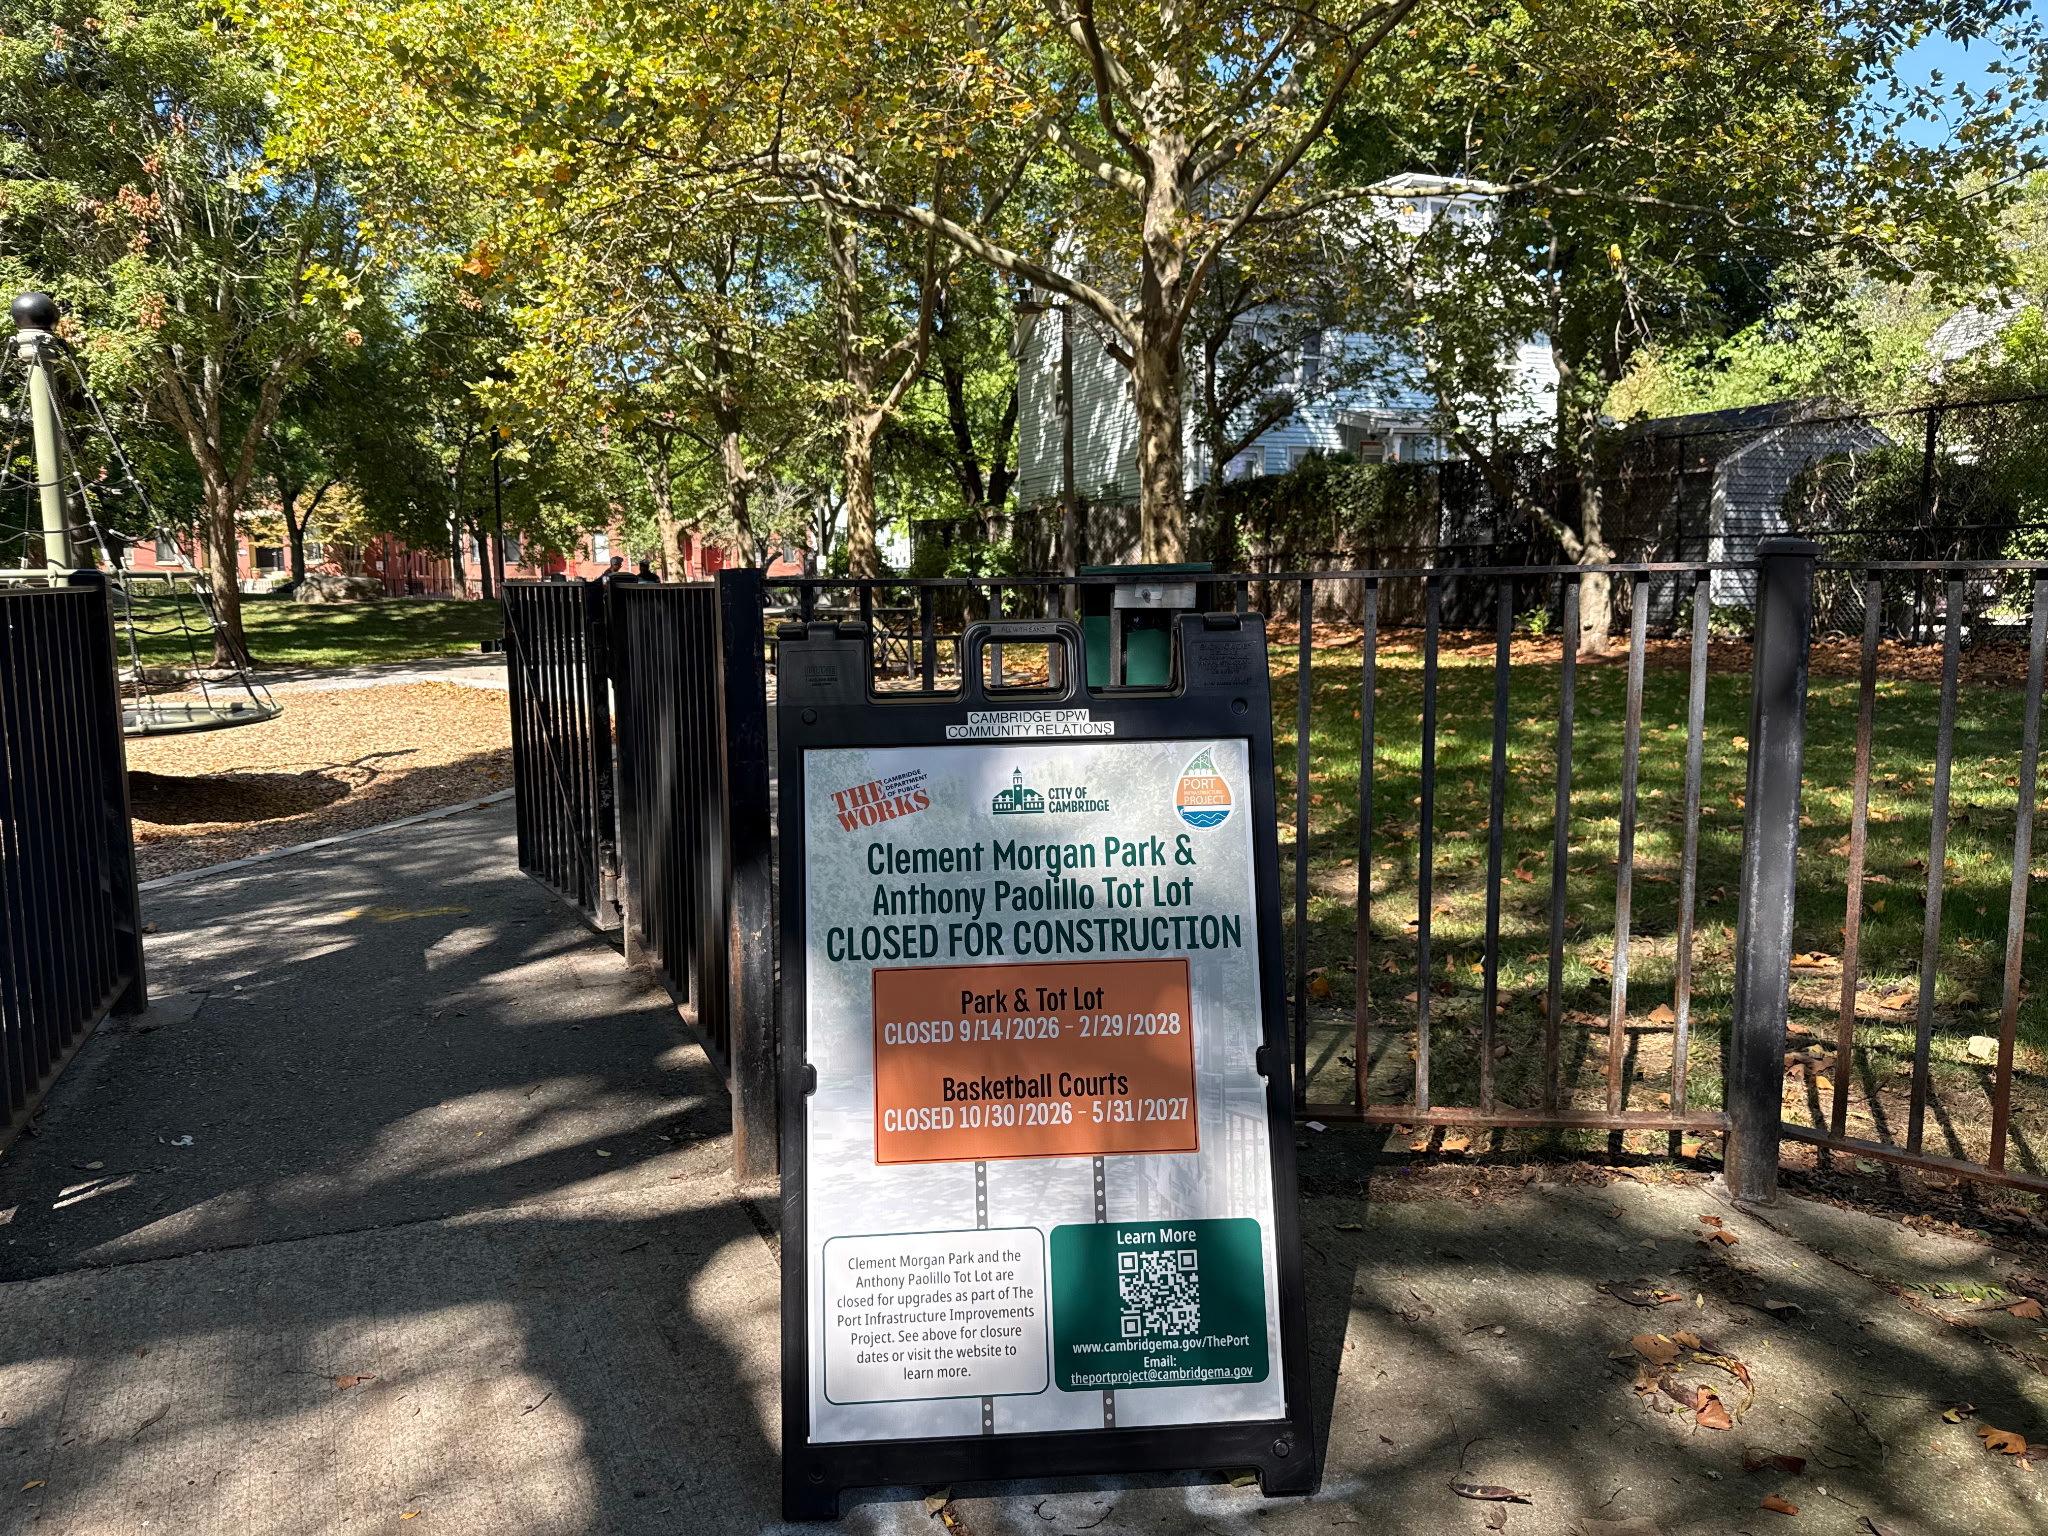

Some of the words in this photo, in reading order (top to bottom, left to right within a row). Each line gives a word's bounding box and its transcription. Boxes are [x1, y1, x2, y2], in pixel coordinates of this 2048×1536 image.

[970, 711, 1052, 724] CAMBRIDGE
[1056, 710, 1087, 722] DPW
[948, 725, 1031, 738] COMMUNITY
[1036, 722, 1112, 735] RELATIONS
[884, 769, 921, 784] CAMBRIDGE
[885, 774, 928, 791] DEPARTMENT
[1183, 778, 1216, 790] PORT
[830, 780, 887, 812] THE
[898, 784, 920, 795] PUBLIC
[1048, 787, 1073, 800] CITY
[1075, 787, 1087, 799] OF
[1184, 795, 1225, 805] PROJECT
[836, 788, 930, 832] WORKS
[1049, 800, 1110, 813] CAMBRIDGE
[867, 842, 984, 875] Clement
[993, 839, 1096, 877] Morgan
[1104, 835, 1166, 868] Park
[1174, 833, 1197, 866] &
[873, 883, 986, 920] Anthony
[994, 876, 1095, 911] Paolillo
[1101, 876, 1145, 908] Tot
[1153, 875, 1194, 907] Lot
[826, 924, 939, 962] CLOSED
[948, 922, 1004, 957] FOR
[1013, 914, 1242, 955] CONSTRUCTION
[961, 989, 1008, 1015] Park
[1013, 988, 1030, 1013] &
[1035, 987, 1067, 1012] Tot
[1073, 986, 1105, 1011] Lot
[884, 1021, 954, 1045] CLOSED
[959, 1016, 1060, 1042] 9/14/2026
[1079, 1012, 1181, 1037] 2/29/2028
[943, 1073, 1052, 1101] Basketball
[1058, 1072, 1129, 1097] Courts
[884, 1106, 955, 1132] CLOSED
[959, 1101, 1073, 1129] 10/30/2026
[1092, 1097, 1189, 1123] 5/31/2027
[1116, 1230, 1156, 1245] Learn
[1159, 1228, 1197, 1243] More
[848, 1256, 896, 1270] Clement
[899, 1254, 945, 1269] Morgan
[949, 1251, 975, 1265] Park
[977, 1250, 999, 1263] and
[1002, 1249, 1021, 1262] the
[855, 1274, 905, 1290] Anthony
[908, 1271, 951, 1286] Paolillo
[953, 1270, 972, 1283] Tot
[974, 1269, 993, 1282] Lot
[995, 1271, 1014, 1282] are
[836, 1294, 874, 1308] closed
[877, 1293, 895, 1306] for
[897, 1290, 952, 1308] upgrades
[955, 1291, 968, 1302] as
[971, 1288, 995, 1304] part
[998, 1287, 1010, 1300] of
[1012, 1285, 1034, 1299] The
[837, 1314, 862, 1328] Port
[865, 1311, 947, 1326] Infrastructure
[949, 1306, 1035, 1323] Improvements
[851, 1332, 895, 1348] Project.
[898, 1330, 919, 1343] See
[922, 1328, 957, 1342] above
[960, 1326, 977, 1340] for
[980, 1325, 1022, 1338] closure
[1072, 1334, 1250, 1353] www.cambridgema.gov/ThePort
[856, 1351, 889, 1364] dates
[891, 1351, 904, 1362] or
[907, 1348, 931, 1361] visit
[934, 1346, 953, 1360] the
[956, 1345, 1002, 1359] website
[1004, 1344, 1017, 1356] to
[1143, 1355, 1177, 1368] Email:
[903, 1367, 934, 1380] learn
[937, 1366, 972, 1379] more.
[1071, 1365, 1253, 1386] theportproject@cambridgema.gov
